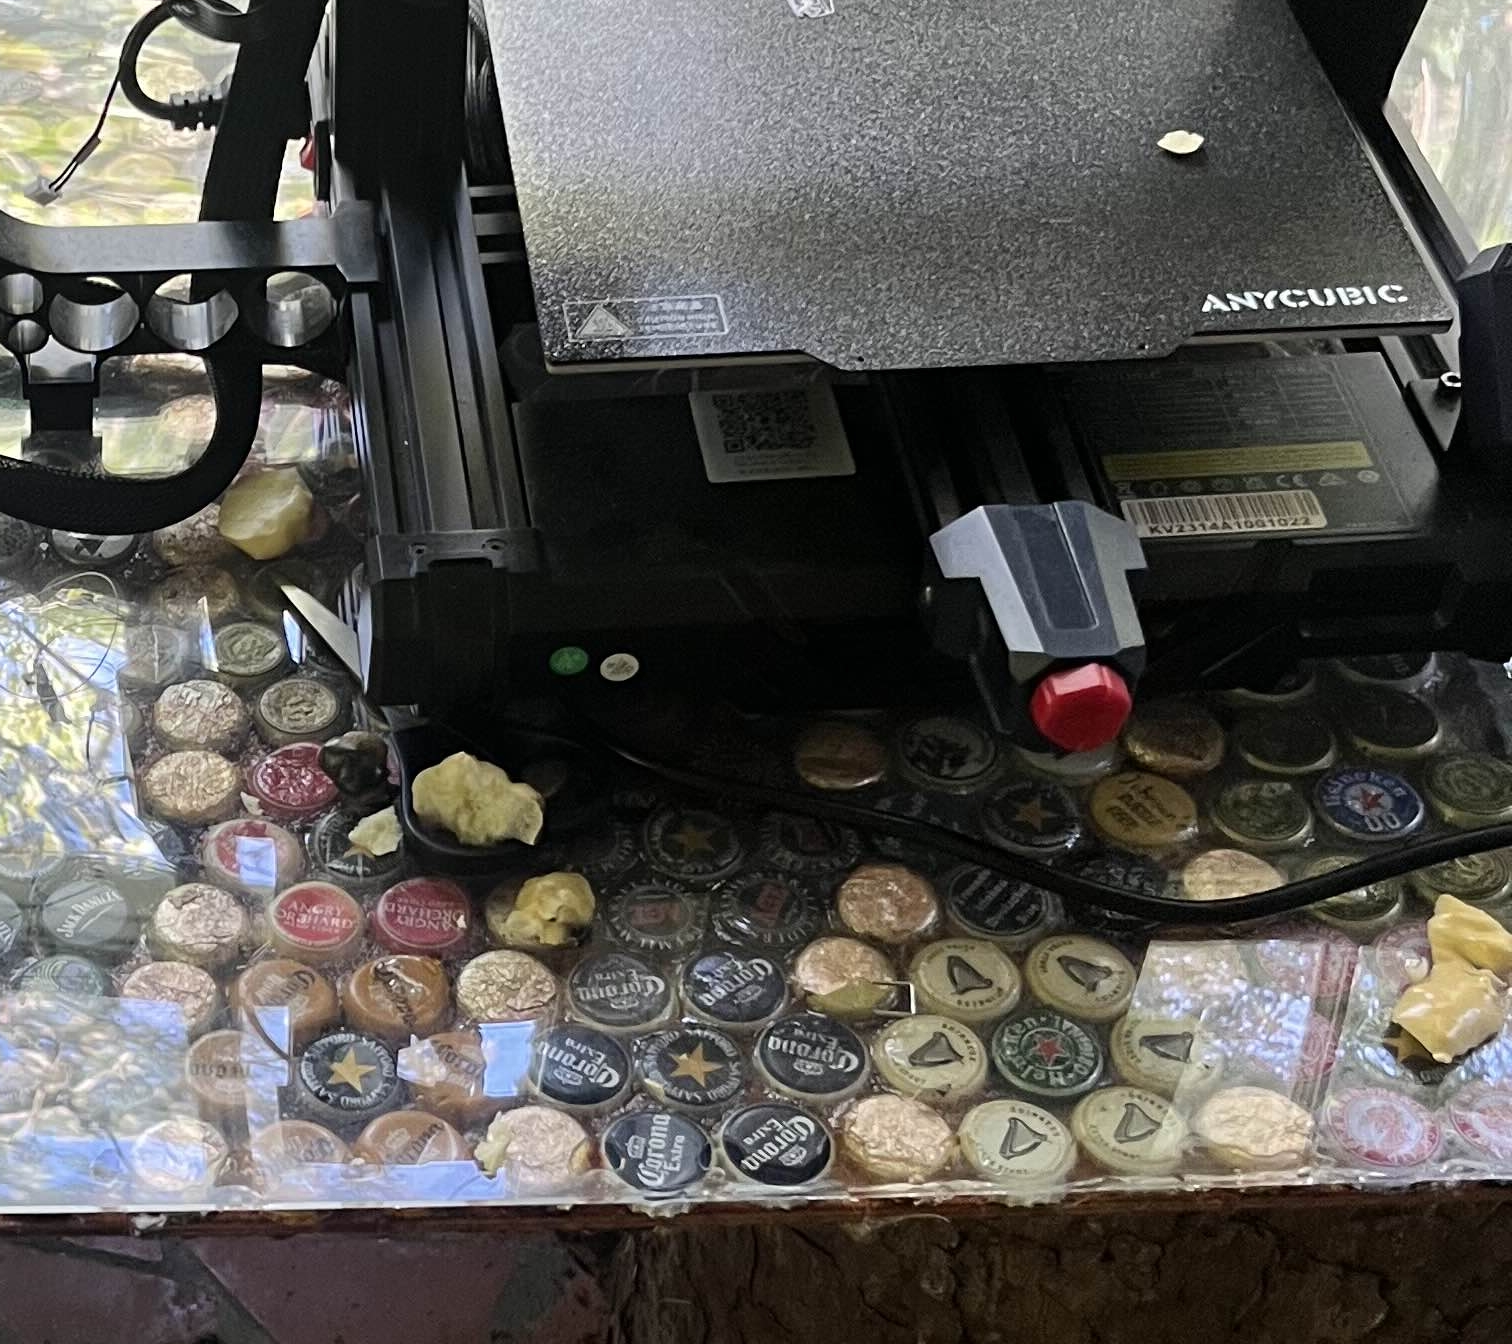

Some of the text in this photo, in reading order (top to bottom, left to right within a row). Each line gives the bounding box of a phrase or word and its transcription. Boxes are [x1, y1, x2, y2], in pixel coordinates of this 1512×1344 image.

[1201, 284, 1409, 313] ANYCUBIC
[289, 900, 345, 918] ANGRY
[578, 975, 666, 1003] Corona
[697, 958, 774, 1008] Corona
[536, 1039, 621, 1089] Corona
[563, 1037, 607, 1065] Extra
[767, 1035, 861, 1073] Corona
[636, 1112, 673, 1188] Corona
[740, 1114, 816, 1172] Corona
[743, 1116, 787, 1147] Extra
[662, 1134, 686, 1174] Extra
